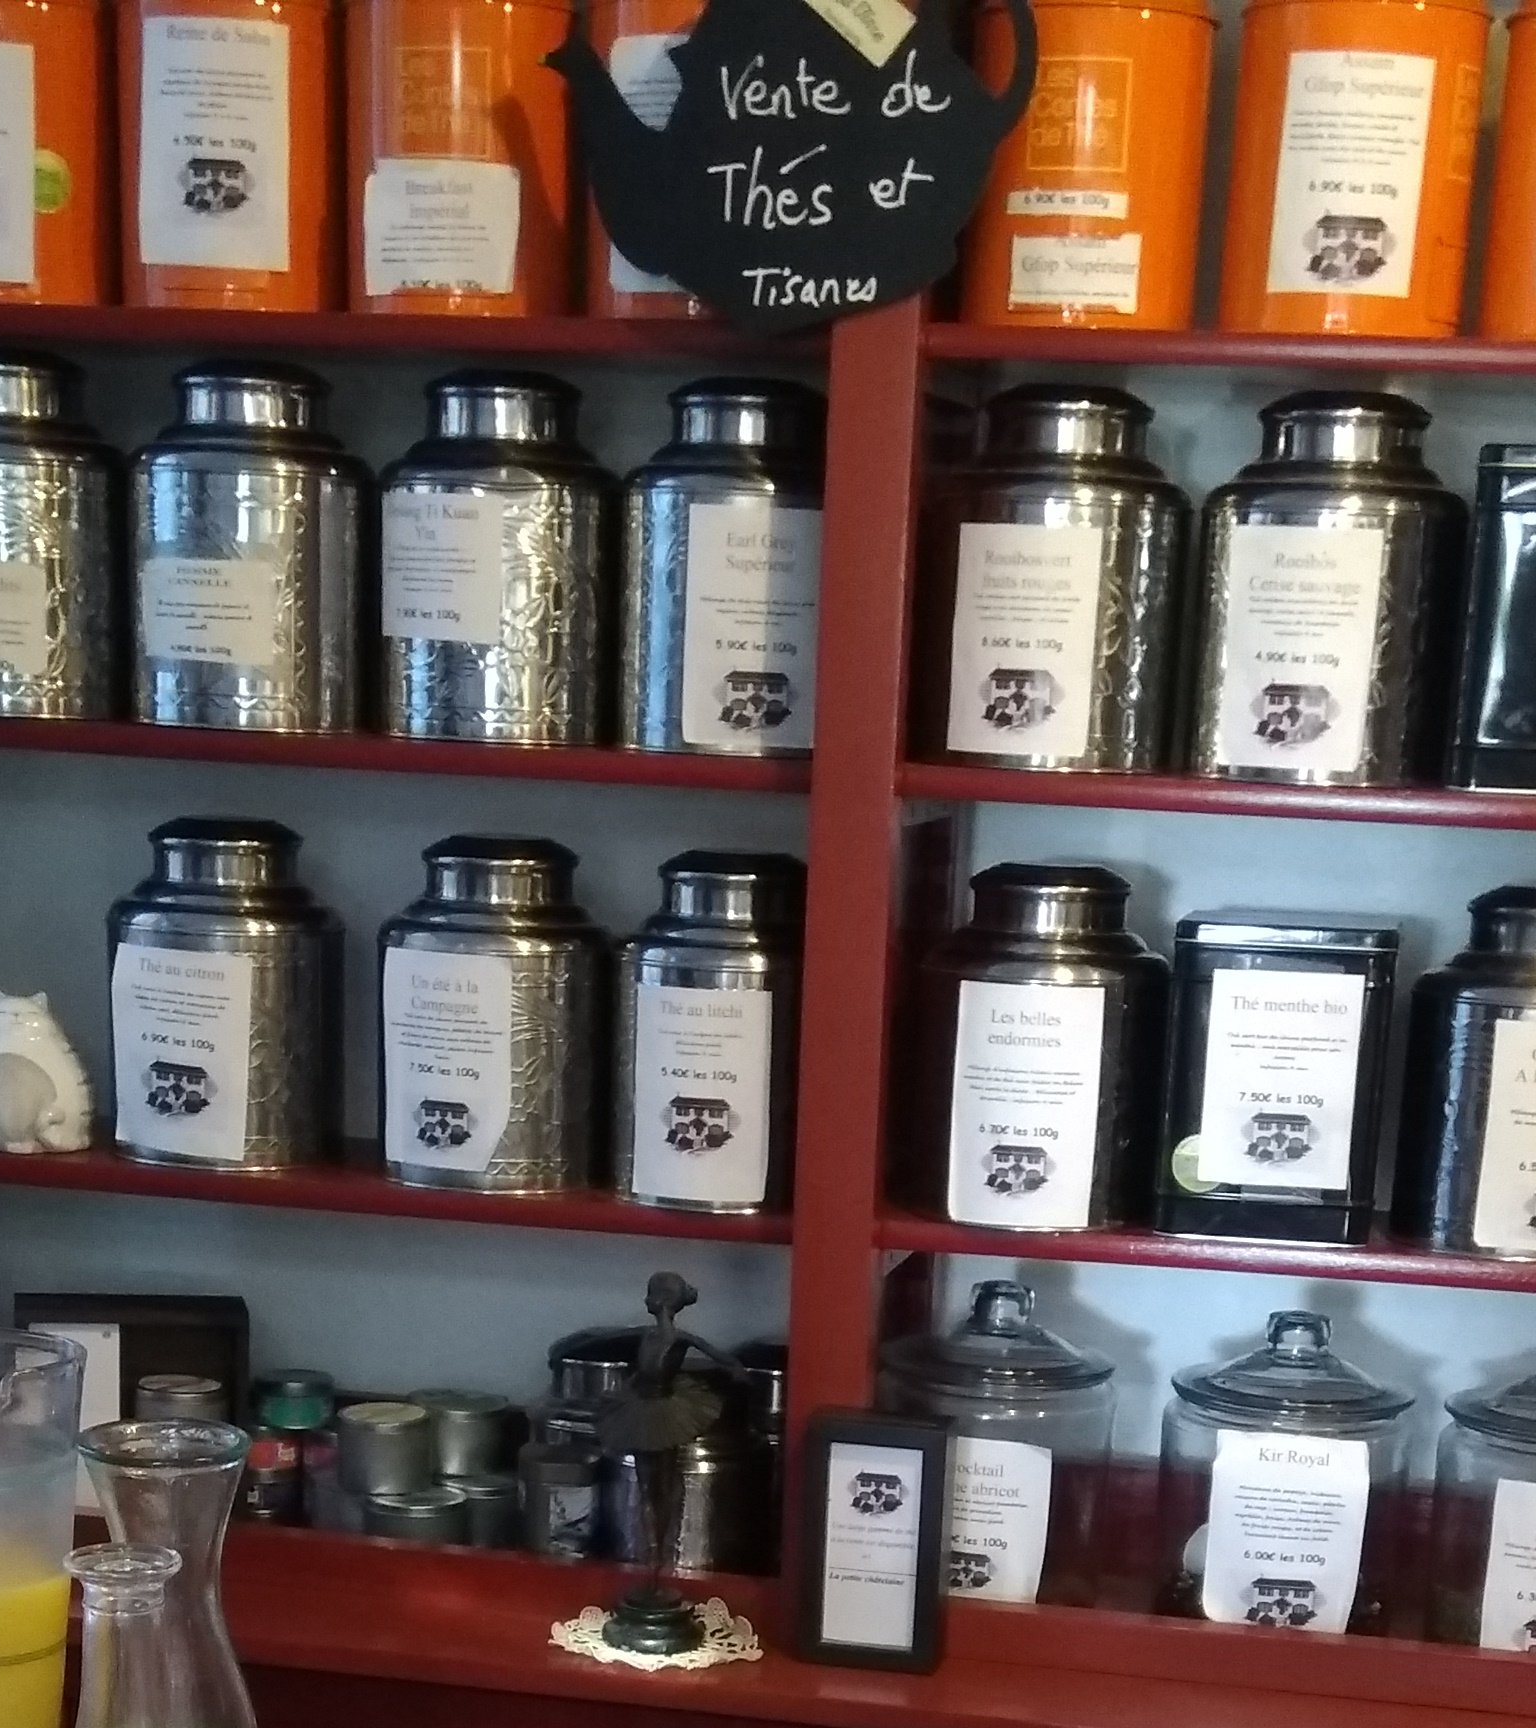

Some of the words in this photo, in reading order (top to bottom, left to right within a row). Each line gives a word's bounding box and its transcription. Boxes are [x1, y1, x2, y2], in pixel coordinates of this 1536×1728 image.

[720, 53, 851, 121] Vente
[881, 48, 952, 118] de
[707, 143, 834, 230] Thés
[869, 156, 935, 210] et
[742, 267, 878, 309] Tisanes
[137, 956, 163, 975] Thé
[165, 963, 182, 977] au
[184, 964, 225, 983] citron
[410, 996, 480, 1018] Campagne
[687, 1004, 704, 1018] au
[1230, 994, 1261, 1011] Thé
[1263, 997, 1321, 1014] menthe
[1323, 999, 1349, 1017] bio
[990, 1008, 1015, 1026] Les
[1019, 1009, 1062, 1028] belles
[172, 1035, 188, 1048] les
[190, 1037, 216, 1054] 100g
[987, 1030, 1062, 1050] endormies
[437, 1063, 452, 1077] les
[454, 1063, 480, 1081] 100g
[692, 1067, 708, 1081] les
[711, 1068, 738, 1085] 100g
[1514, 1069, 1529, 1084] A
[1276, 1092, 1292, 1105] les
[1296, 1093, 1324, 1109] 100g
[1012, 1124, 1029, 1138] les
[1032, 1125, 1059, 1142] 100g
[1258, 1447, 1284, 1464] Kir
[1287, 1449, 1331, 1469] Royal
[955, 1462, 1005, 1480] ocktail
[971, 1482, 1020, 1499] abricot
[963, 1536, 978, 1548] les
[983, 1536, 1008, 1551] 100g
[1279, 1550, 1294, 1563] les
[1299, 1551, 1326, 1567] 100g
